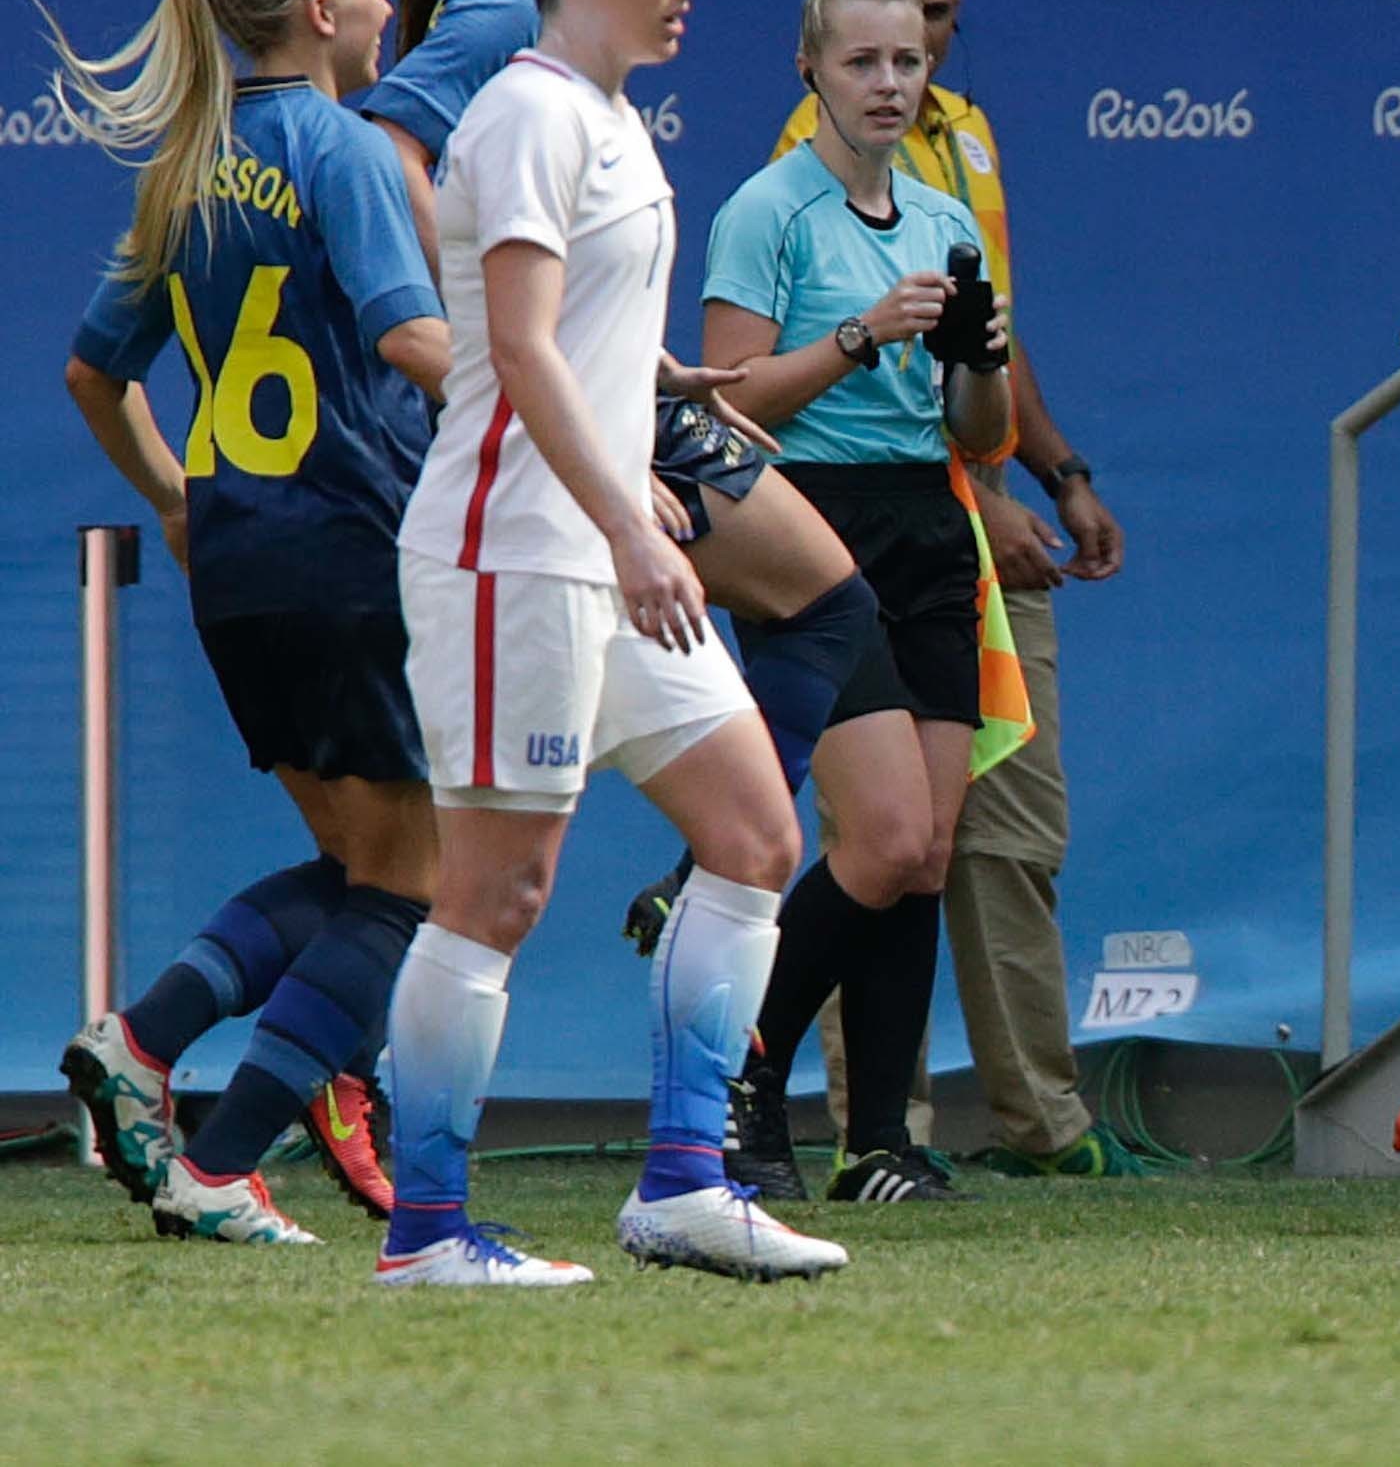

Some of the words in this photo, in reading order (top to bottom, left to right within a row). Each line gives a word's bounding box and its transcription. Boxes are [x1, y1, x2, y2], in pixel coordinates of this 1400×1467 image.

[1088, 88, 1254, 138] Rio2016
[169, 266, 318, 477] 16
[526, 733, 580, 768] USA
[1122, 936, 1173, 964] NBC
